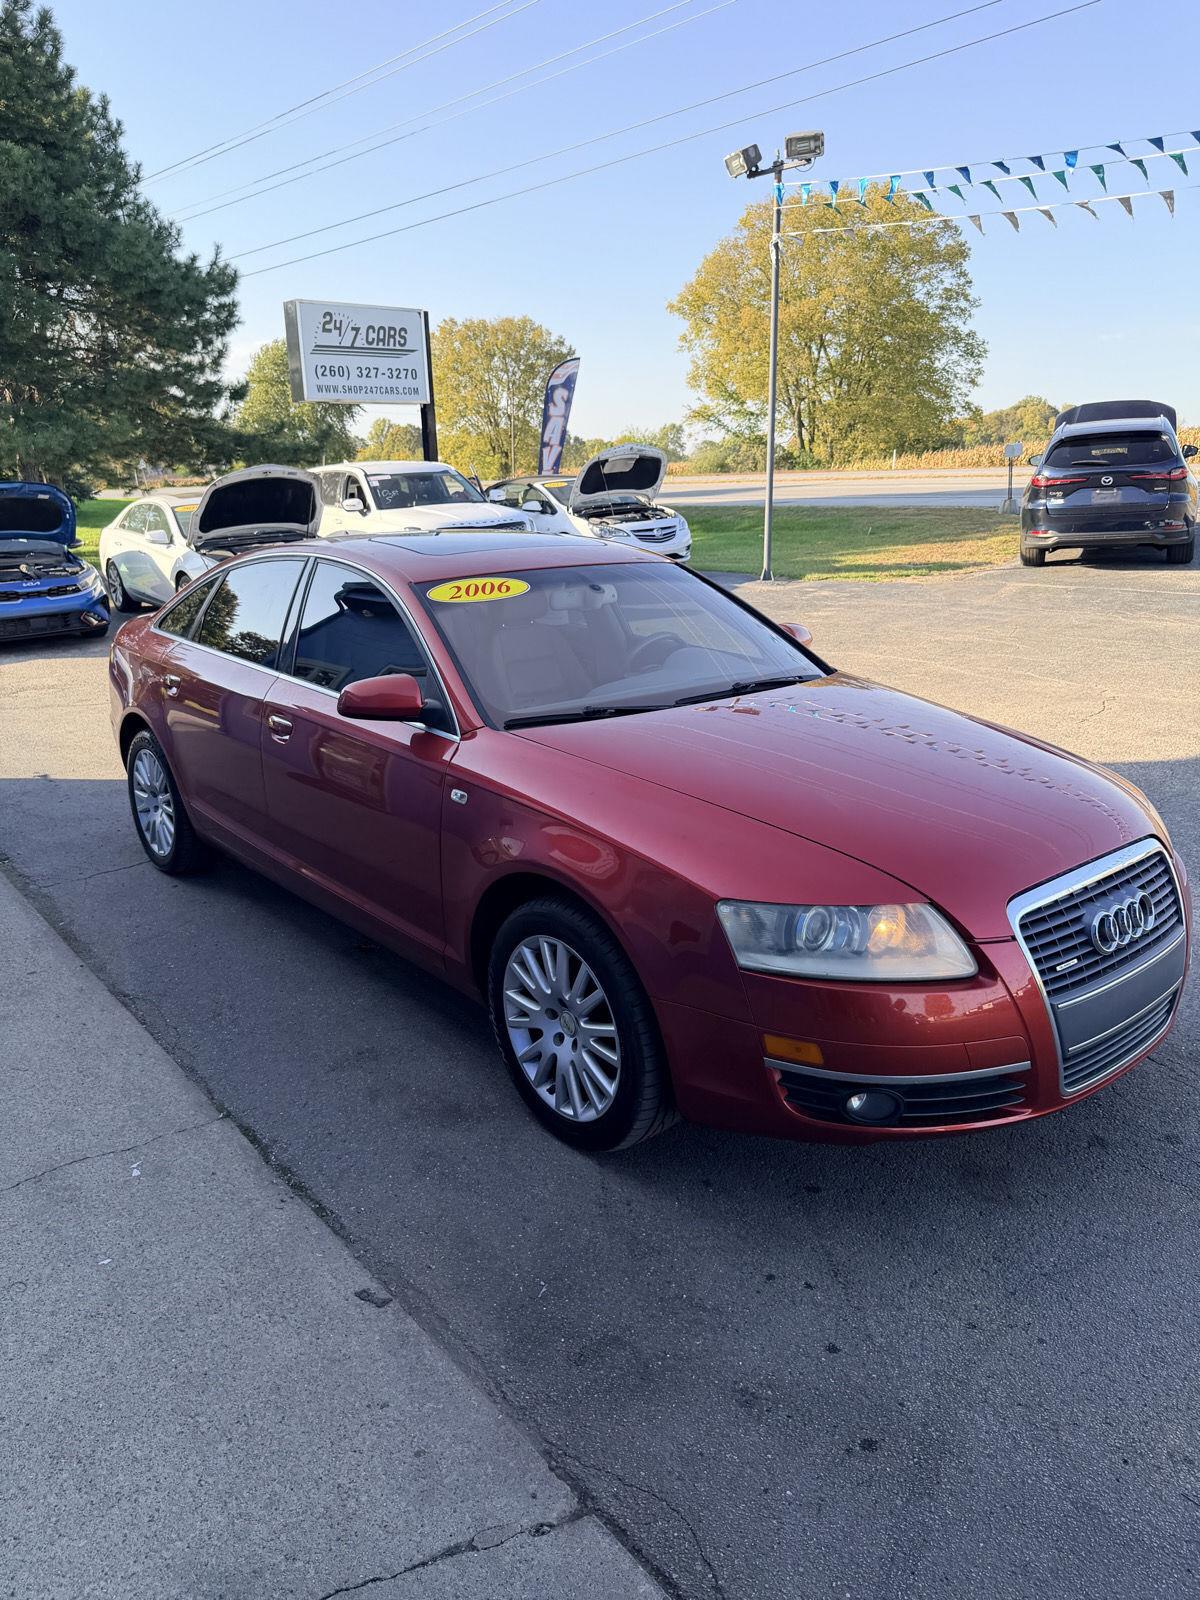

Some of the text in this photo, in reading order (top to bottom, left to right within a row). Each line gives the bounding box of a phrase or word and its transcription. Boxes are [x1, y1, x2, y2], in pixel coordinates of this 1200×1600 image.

[321, 311, 408, 348] 24/7 CARS
[314, 364, 418, 381] (260) 327-3270
[316, 384, 420, 396] WWW.SHOP247CARS.COM
[541, 386, 569, 475] SAV
[448, 580, 511, 600] 2006
